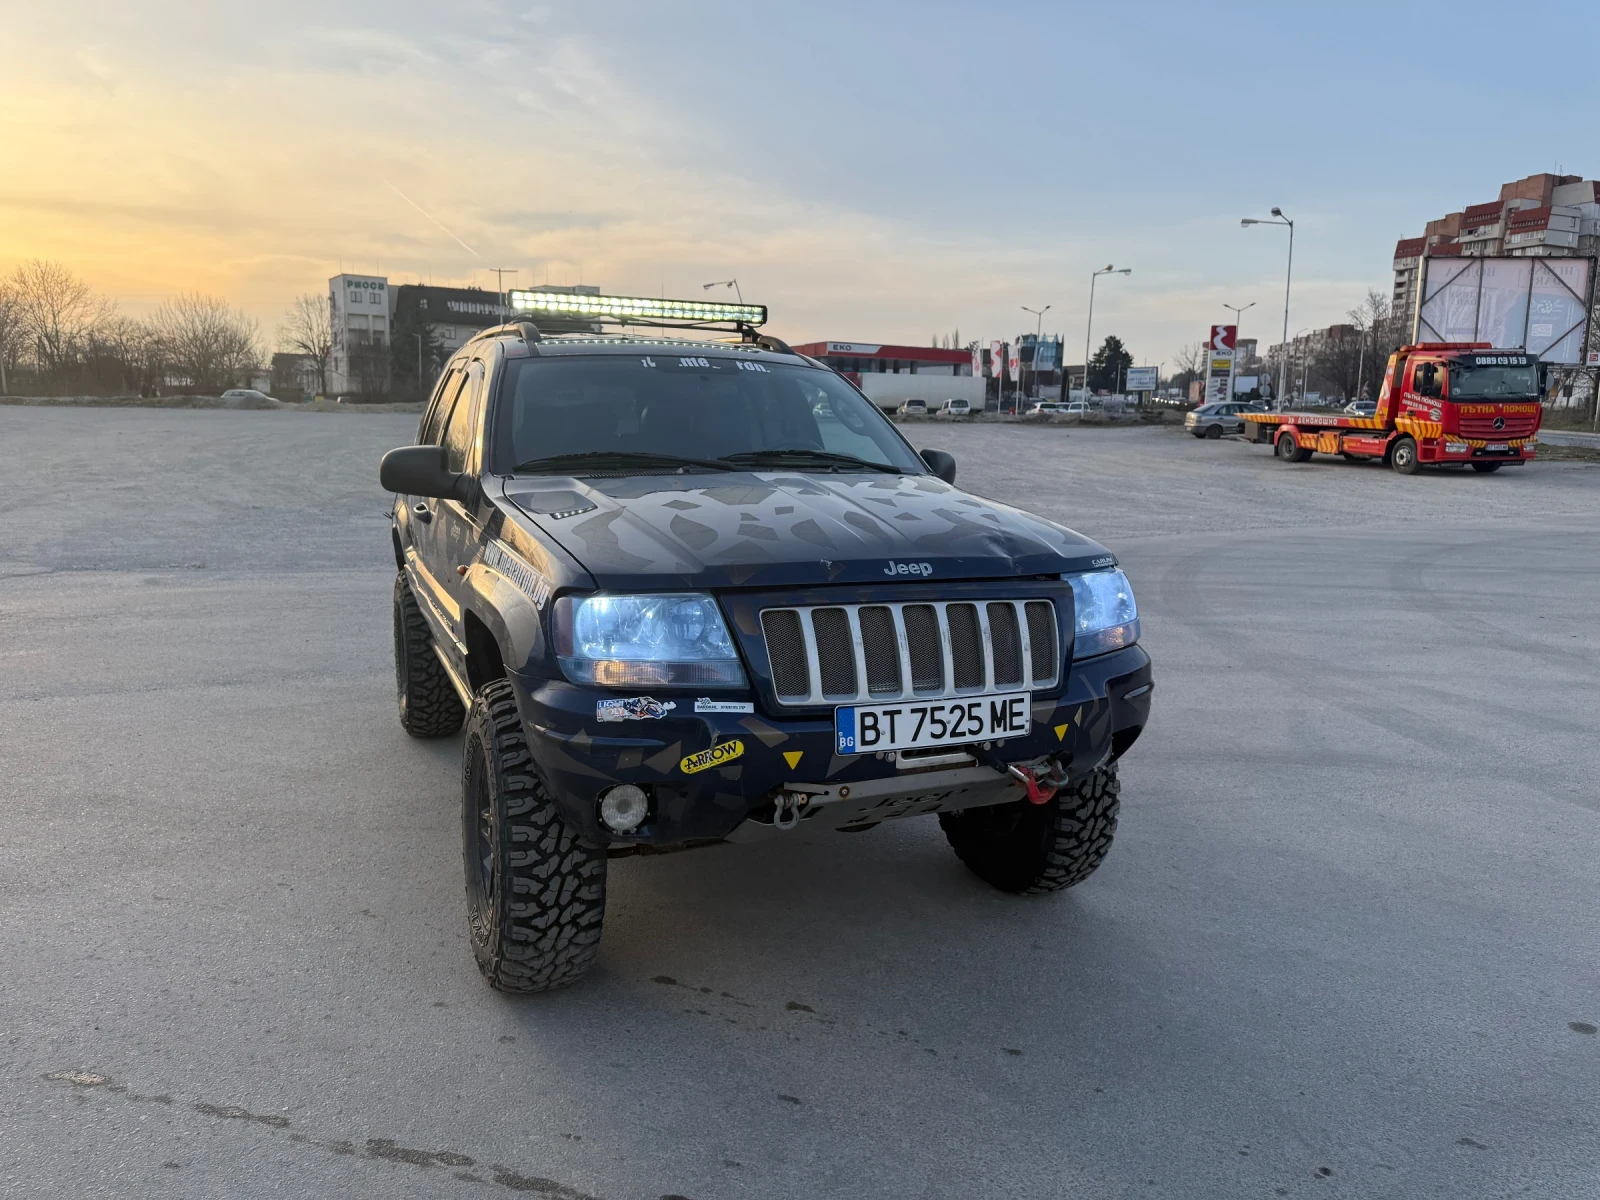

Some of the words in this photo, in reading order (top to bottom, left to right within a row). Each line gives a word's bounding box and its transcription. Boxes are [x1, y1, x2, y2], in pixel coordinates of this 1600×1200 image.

[1475, 356, 1497, 365] 0889
[1460, 405, 1496, 414] ПЪТНА
[1503, 405, 1537, 414] ПОМОЩ
[884, 560, 932, 577] Jeep
[860, 709, 902, 747] BT
[910, 702, 984, 742] 7525
[990, 698, 1026, 734] ME
[839, 736, 854, 747] BG
[684, 741, 737, 770] ARROW
